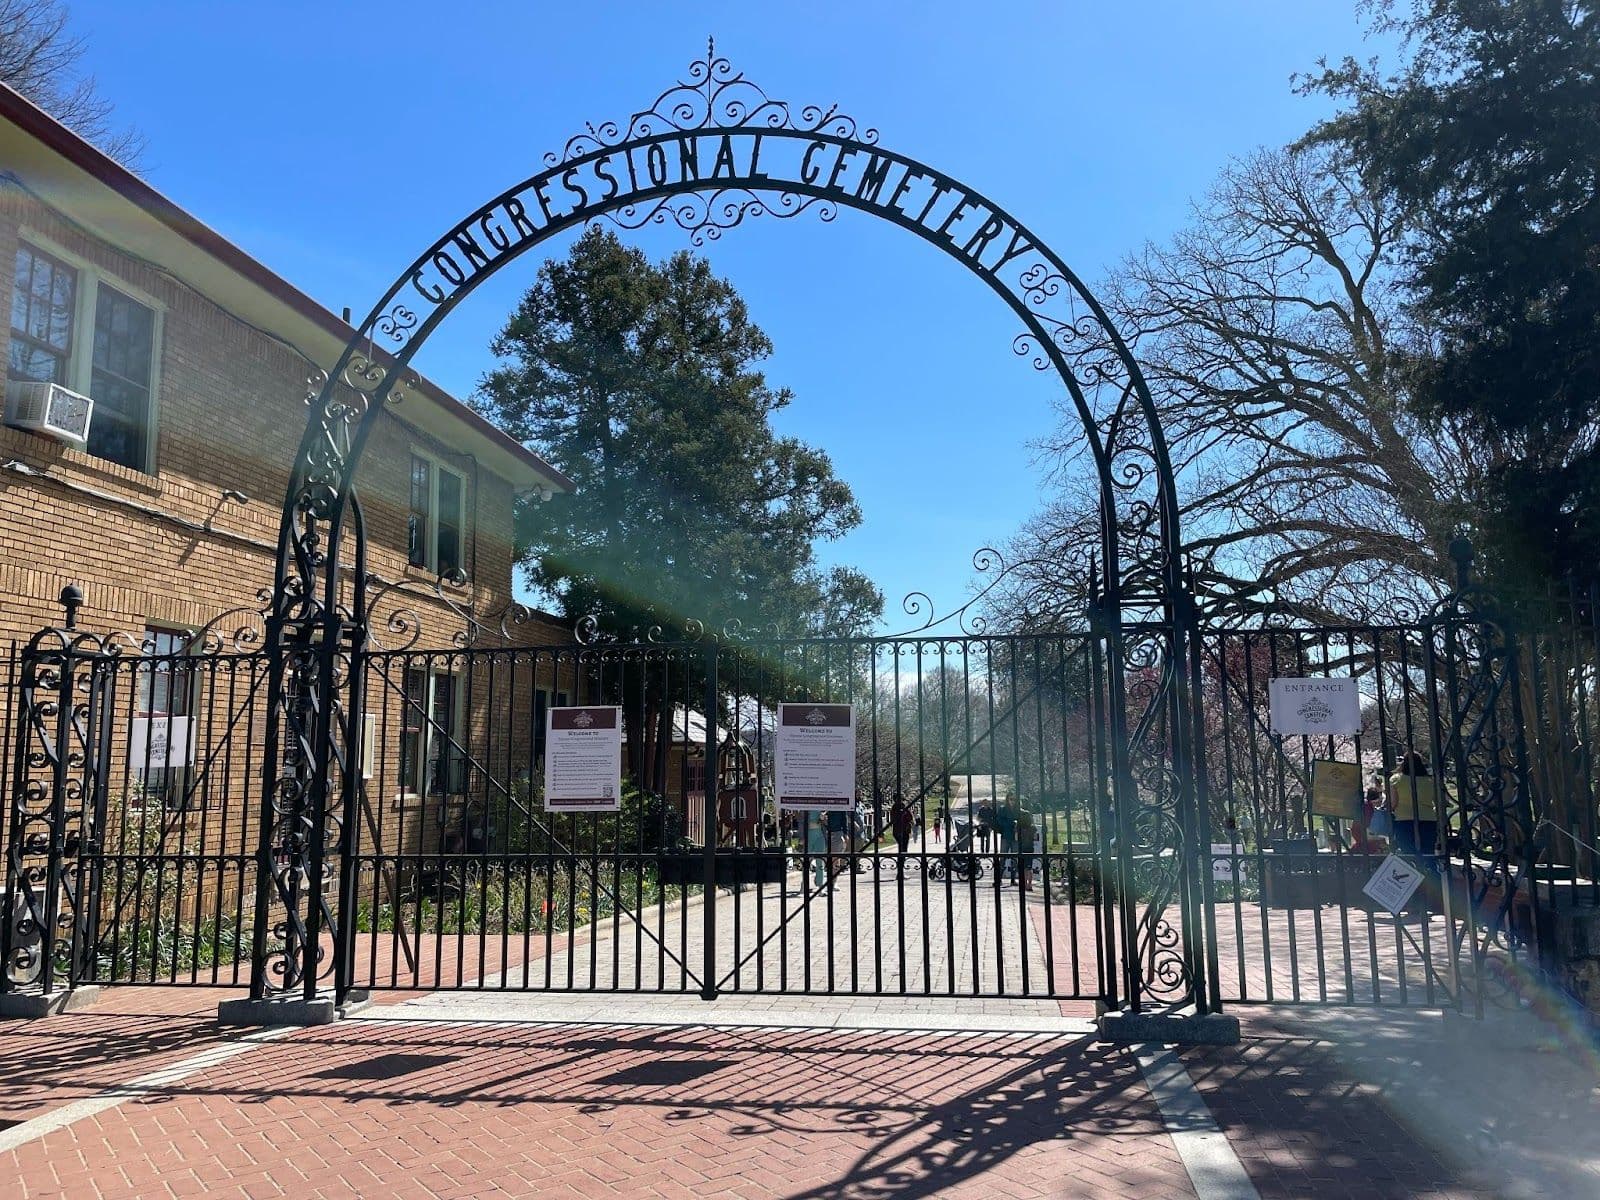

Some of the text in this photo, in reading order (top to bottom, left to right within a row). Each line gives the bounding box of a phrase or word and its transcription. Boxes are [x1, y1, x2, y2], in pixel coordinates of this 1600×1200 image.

[412, 134, 1035, 304] CONGRESSIONAL CEMETERY
[1284, 684, 1344, 692] ENTRANCE
